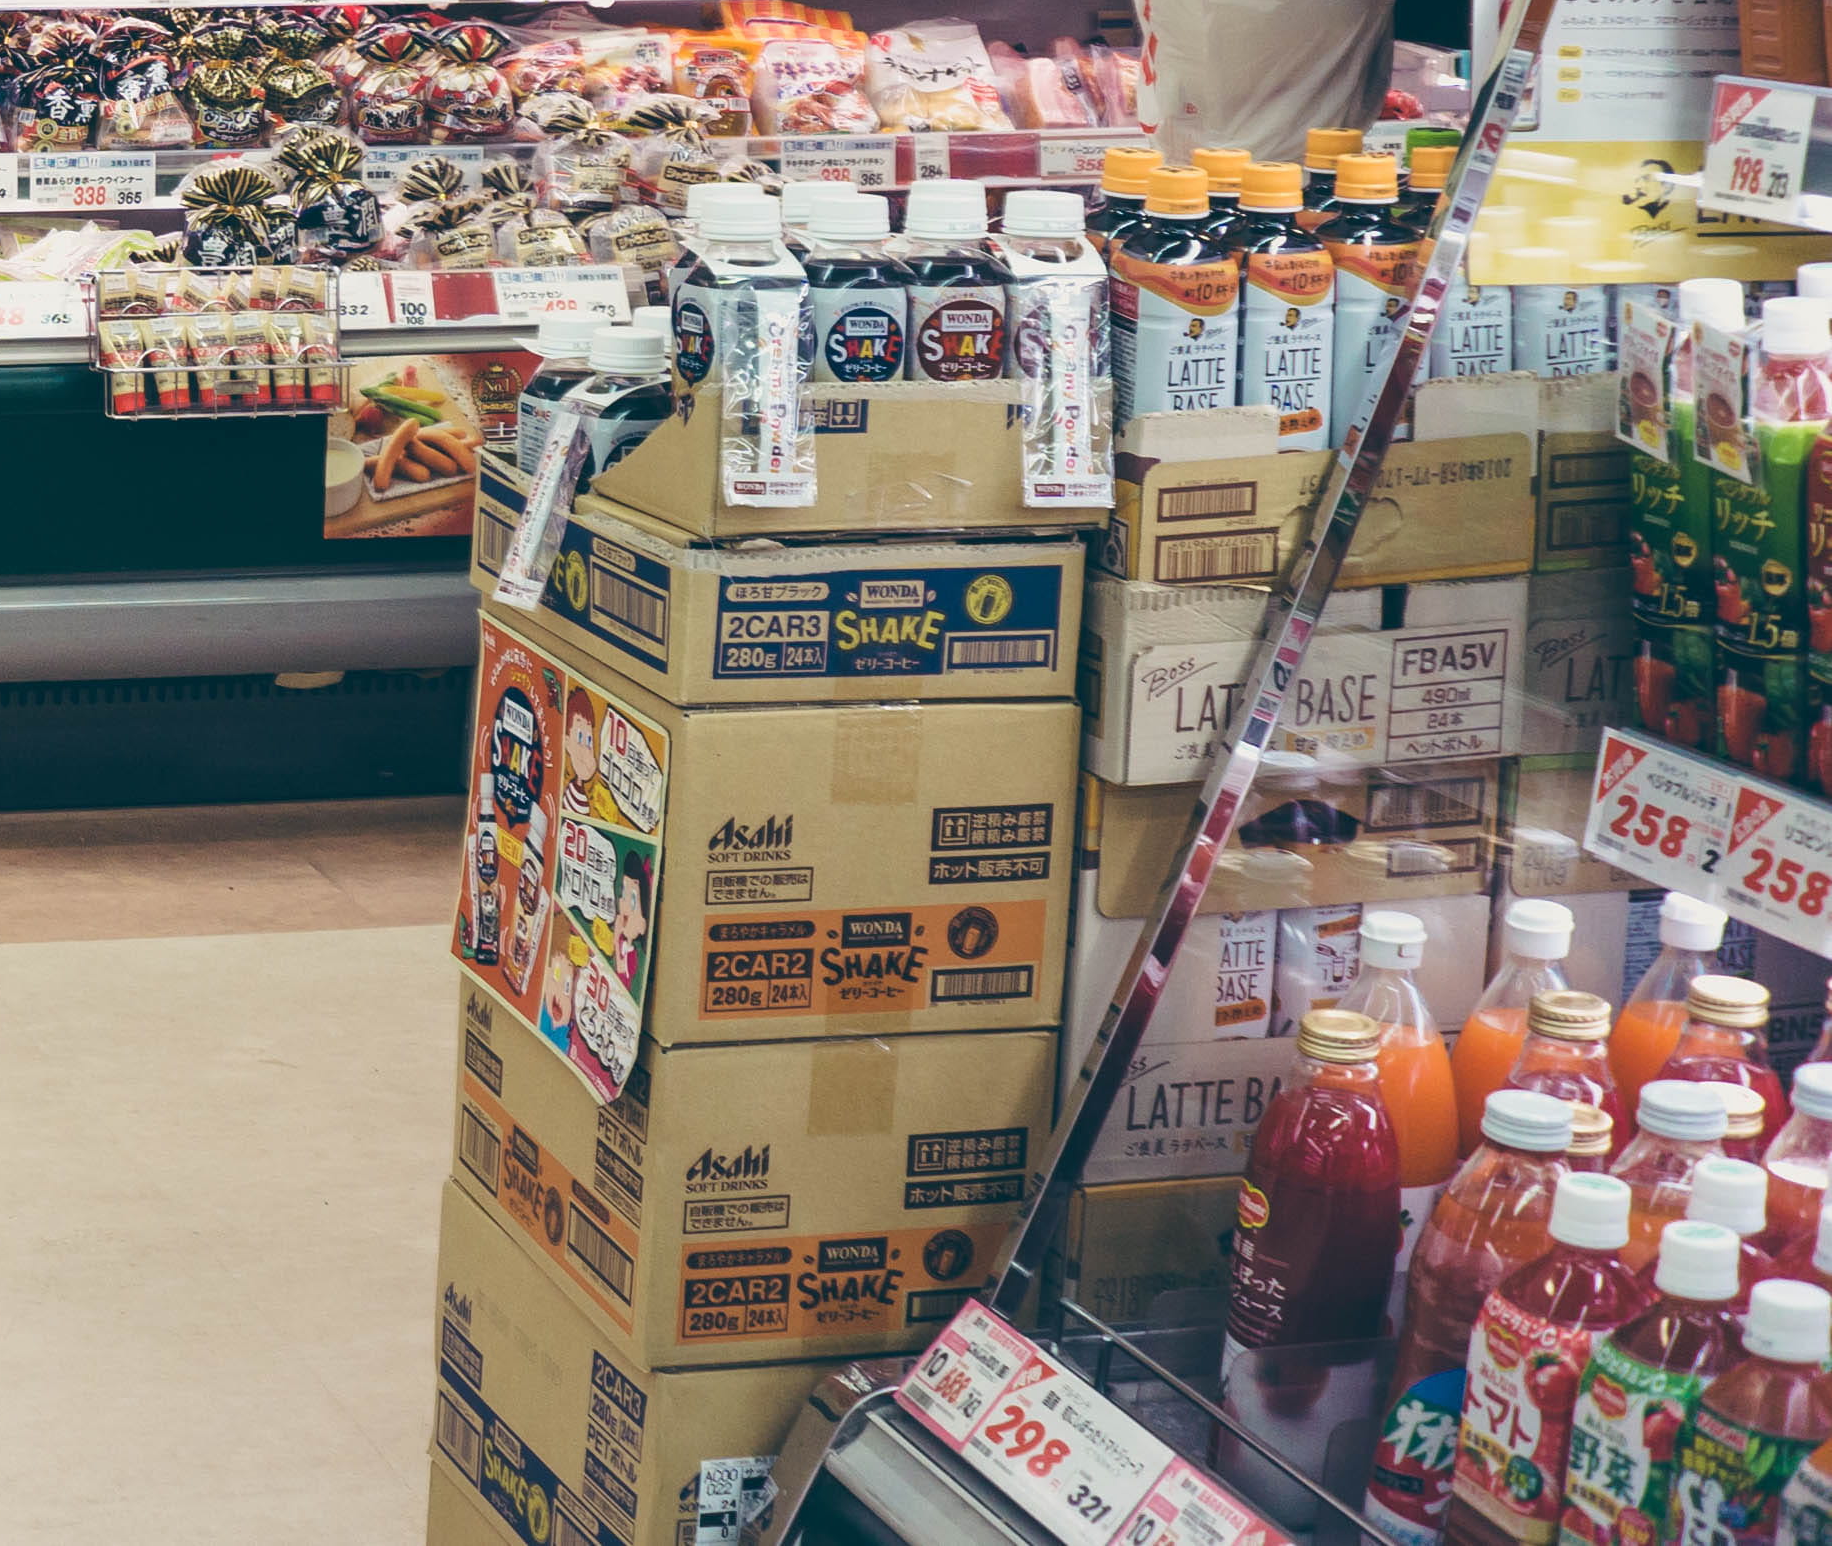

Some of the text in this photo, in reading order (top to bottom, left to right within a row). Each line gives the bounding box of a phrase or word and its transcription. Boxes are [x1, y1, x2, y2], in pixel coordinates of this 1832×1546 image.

[72, 184, 107, 207] 338
[945, 310, 989, 330] WONDA
[939, 361, 991, 375] ゼリーコーヒー
[1167, 356, 1226, 386] LATTE
[1264, 348, 1321, 378] LATTE
[1270, 385, 1315, 411] BASE
[1714, 498, 1776, 545] リッチ
[732, 583, 823, 601] ほろ甘ブラック
[866, 584, 920, 601] WONDA
[727, 616, 822, 639] 2CAR3
[835, 609, 947, 651] SHAKE
[726, 645, 824, 671] 280g 24本入
[854, 656, 920, 670] ゼリーコーヒー
[1402, 642, 1497, 676] FBA5V
[1295, 675, 1377, 725] BASE
[708, 814, 794, 853] Asahi
[708, 850, 792, 863] SOFT DRINKS
[933, 858, 1045, 880] ホット販売不可
[711, 873, 809, 889] 自販機での販売は
[850, 920, 904, 935] WONDA
[713, 954, 809, 979] 2CAR2
[819, 945, 929, 986] SHAKE
[1125, 1079, 1235, 1131] LATTE
[685, 1143, 771, 1183] Asahi
[910, 1181, 1020, 1204] ホット販売不可
[691, 1280, 785, 1304] 2CAR2
[795, 1270, 904, 1311] SHAKE
[985, 1404, 1113, 1524] 298 321
[1570, 1427, 1640, 1503] 野菜
